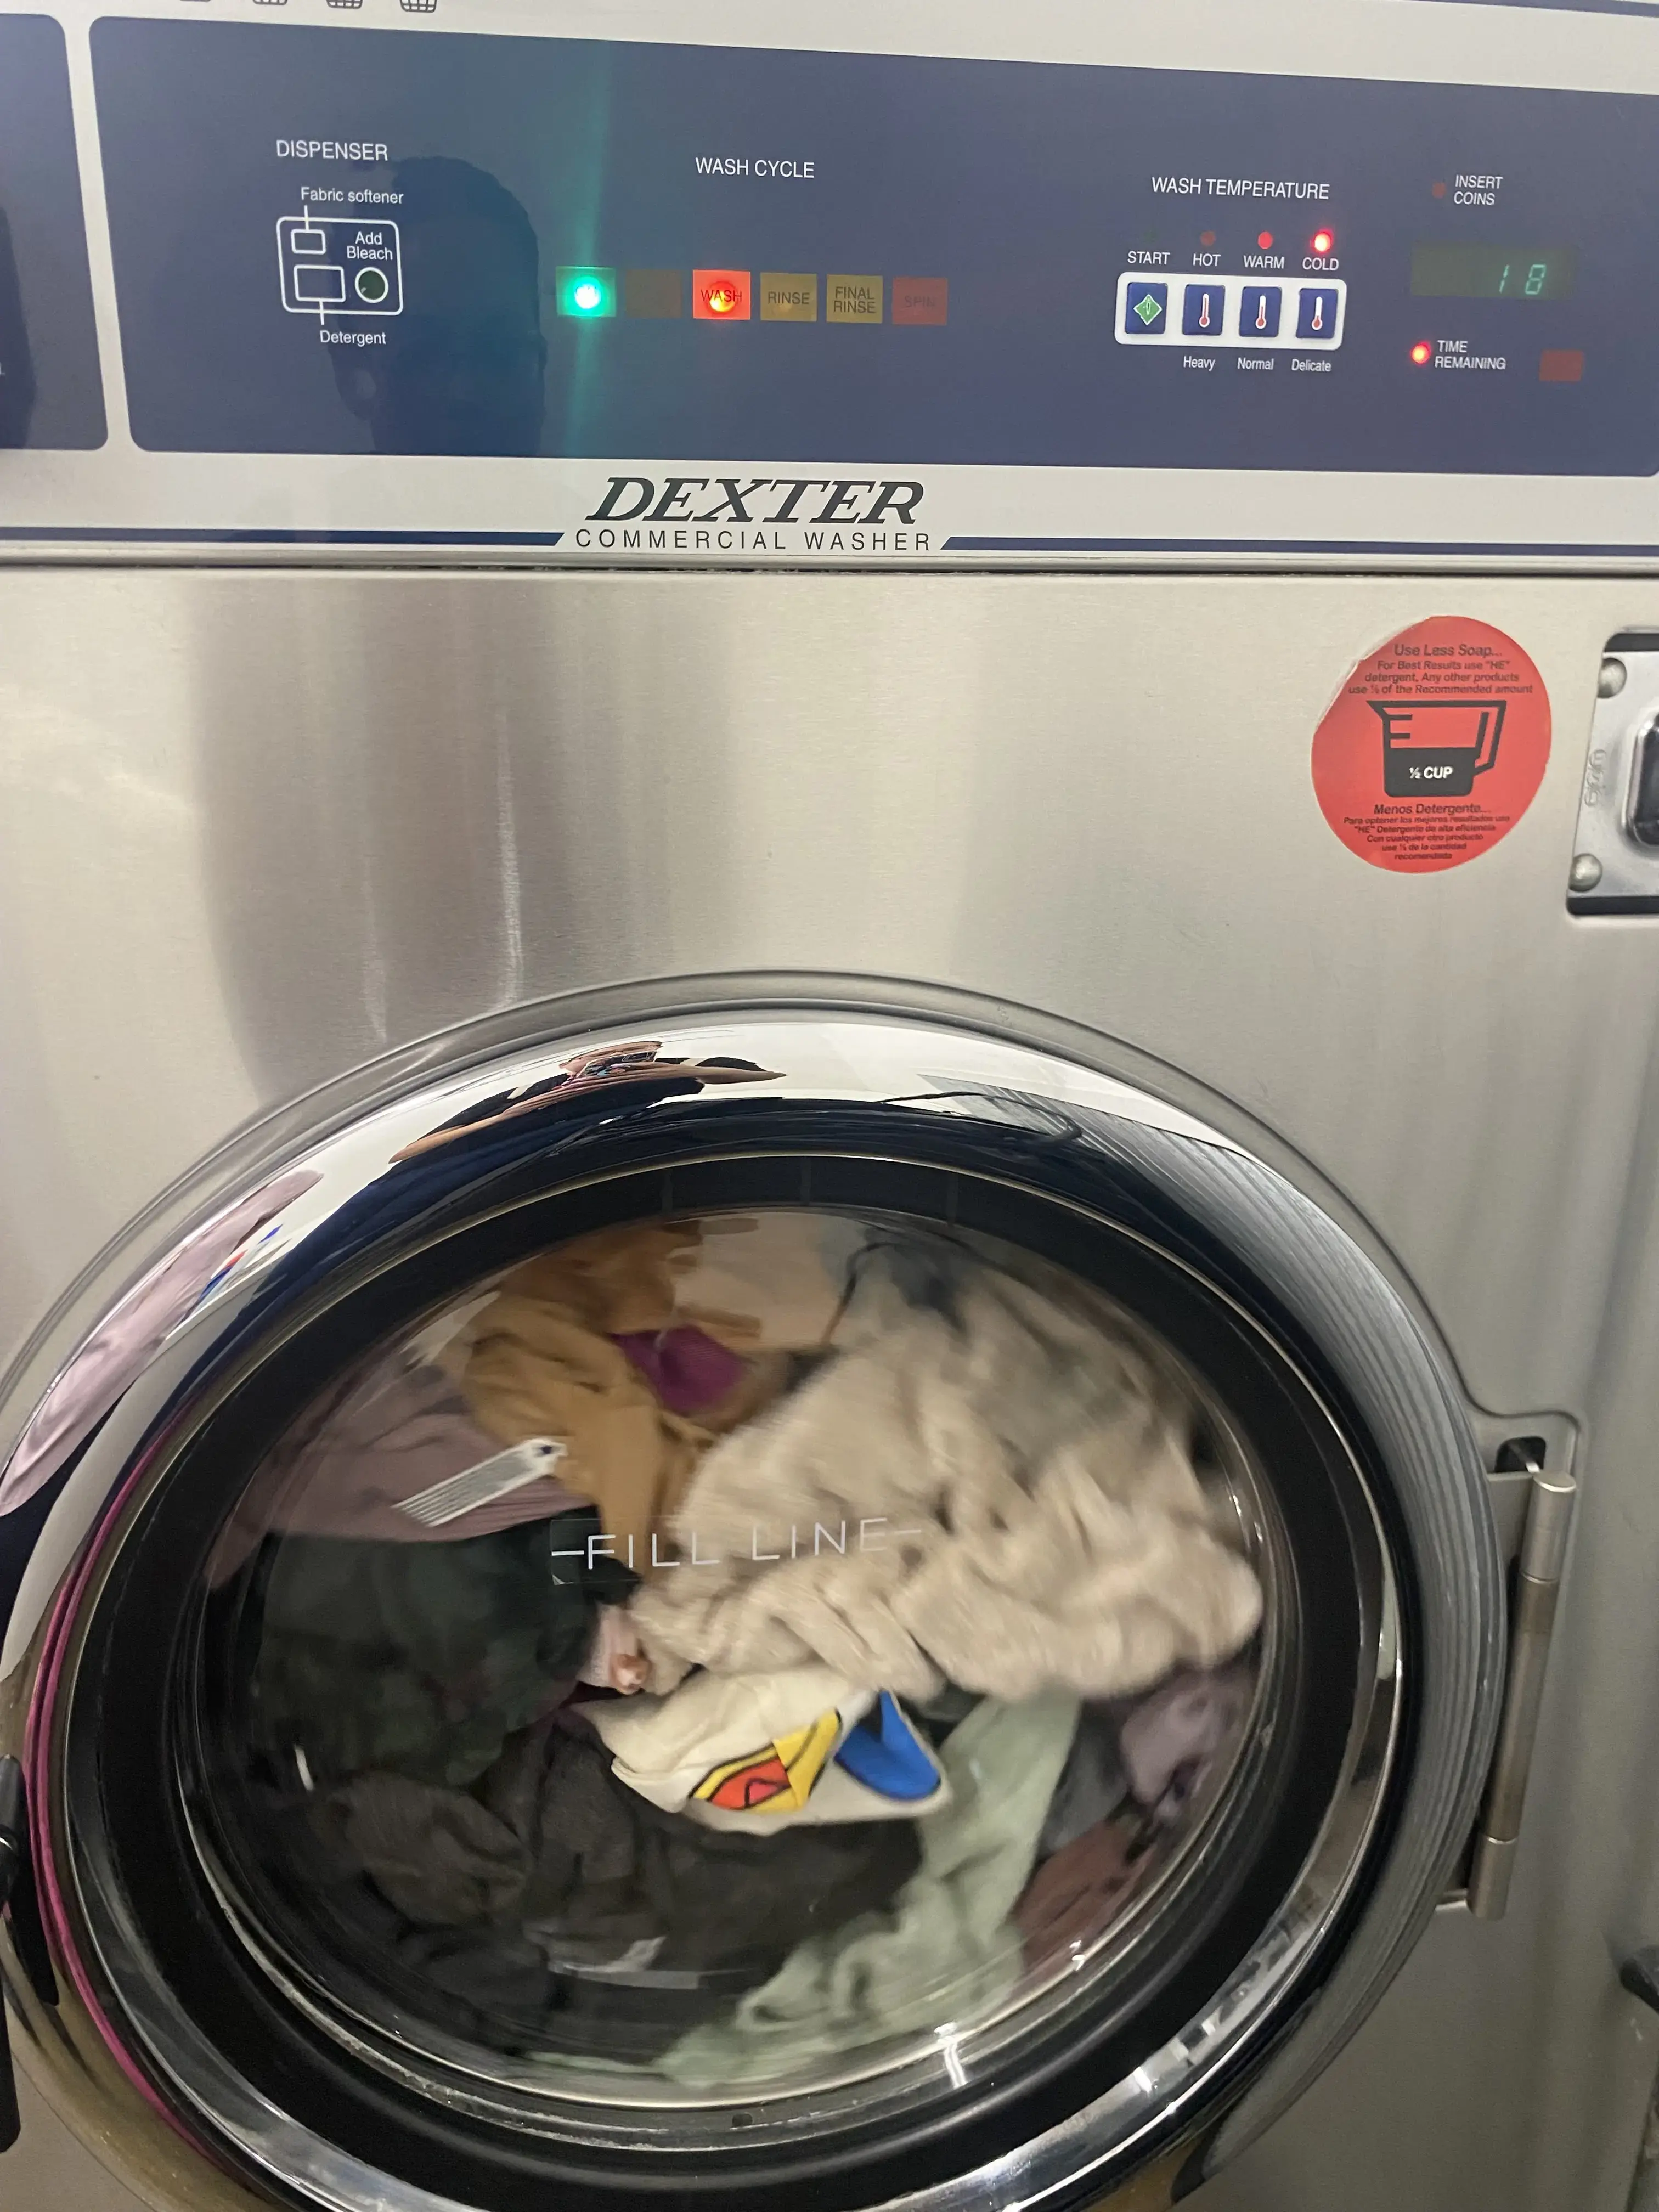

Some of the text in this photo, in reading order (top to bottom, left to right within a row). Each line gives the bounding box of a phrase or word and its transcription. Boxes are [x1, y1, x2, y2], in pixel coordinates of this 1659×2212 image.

[276, 139, 388, 161] DISPENSER
[695, 157, 815, 178] WASH CYCLE
[1152, 177, 1330, 200] WASH TEMPERATURE
[1455, 174, 1503, 189] INSERT
[301, 186, 404, 204] Fabric softener
[1453, 191, 1496, 206] COINS
[355, 230, 382, 245] Add
[346, 245, 393, 261] Bleach
[1127, 250, 1170, 265] START
[1193, 253, 1221, 267] HOT
[1243, 255, 1285, 269] WARM
[1302, 257, 1340, 271] COLD
[1499, 264, 1547, 295] 18
[701, 289, 743, 303] WASH
[768, 291, 810, 306] RINSE
[834, 286, 875, 301] FINAL
[833, 301, 876, 314] RINSE
[320, 330, 387, 347] Detergent
[1437, 340, 1468, 353] TIME
[1183, 355, 1216, 371] Heavy
[1237, 357, 1274, 370] Normal
[1291, 358, 1332, 372] Delicate
[1434, 356, 1506, 370] REMAINING
[585, 476, 924, 524] DEXTER
[575, 529, 930, 551] COMMERCIAL WASHER
[1393, 644, 1420, 656] Use
[1424, 644, 1455, 656] Less
[1377, 660, 1395, 669] For
[1397, 660, 1421, 669] Best
[1423, 659, 1462, 669] Results
[1421, 672, 1441, 684] Any
[1443, 672, 1470, 682] other
[1473, 673, 1520, 683] products
[1348, 686, 1368, 694] use
[1381, 684, 1392, 694] of
[1395, 685, 1413, 694] the
[1415, 684, 1492, 694] Recommended
[1494, 685, 1533, 694] amount
[1423, 766, 1454, 779] CUP
[1374, 804, 1412, 815] Menos
